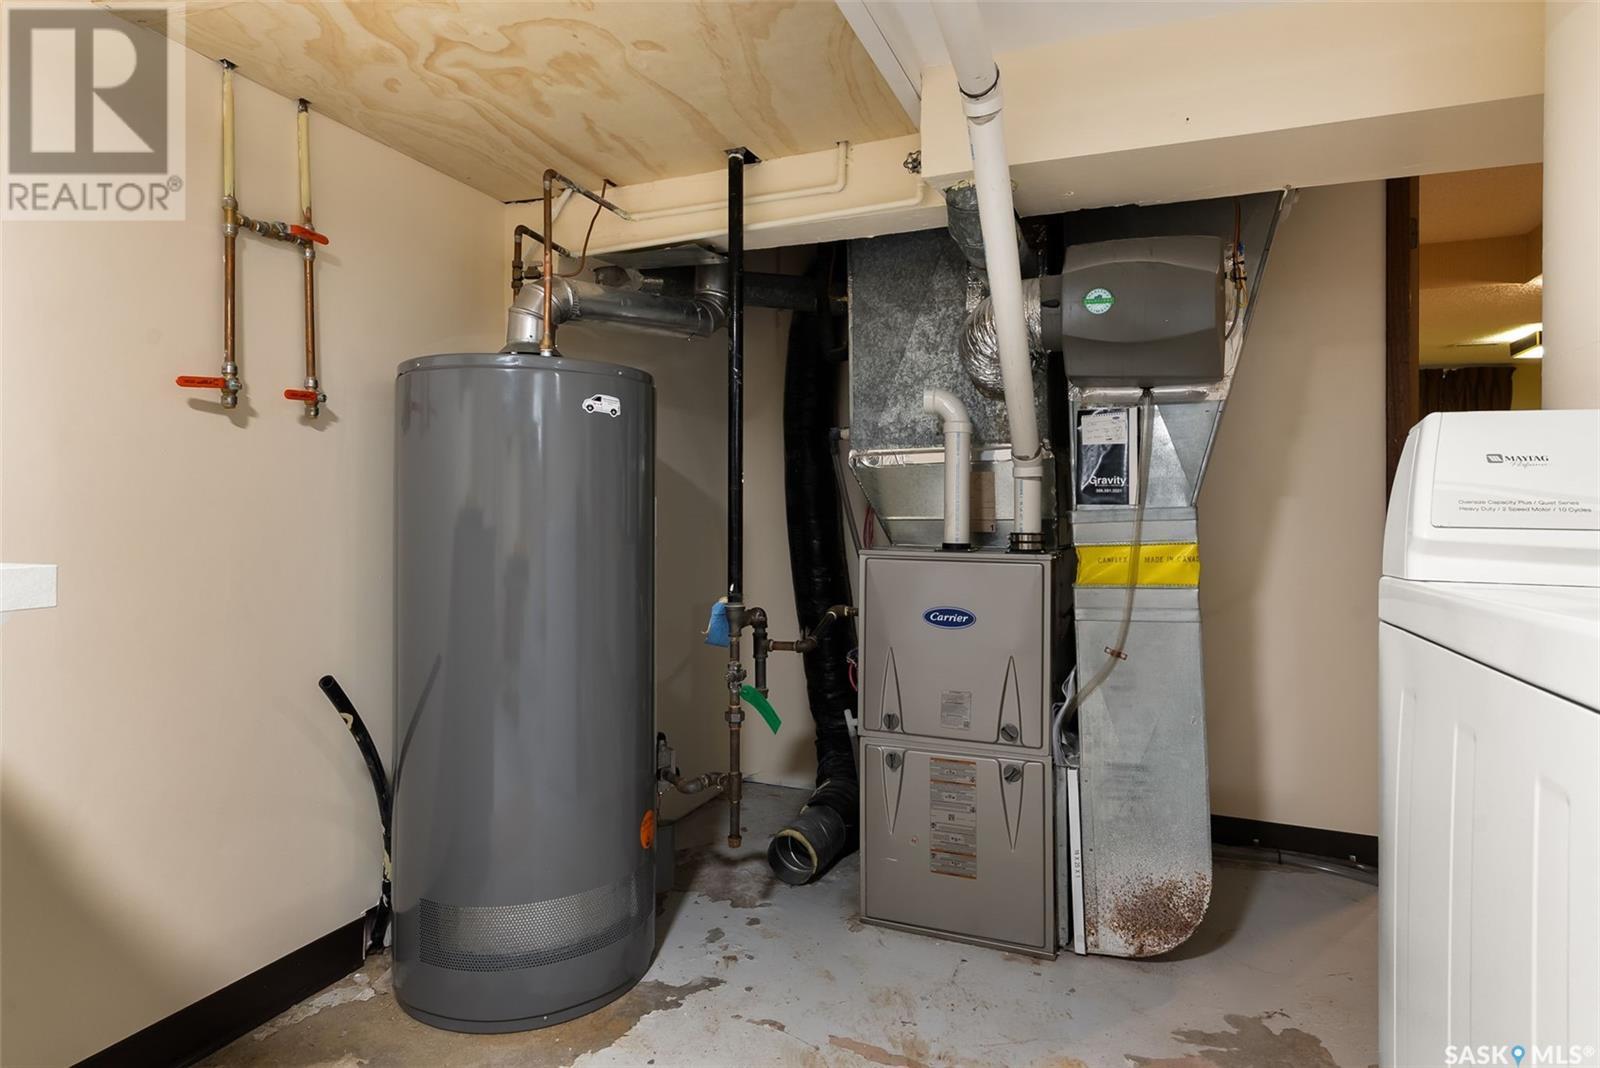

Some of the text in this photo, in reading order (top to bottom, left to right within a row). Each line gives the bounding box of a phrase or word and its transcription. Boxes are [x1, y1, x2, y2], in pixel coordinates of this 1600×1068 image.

[1089, 475, 1127, 487] Gravity
[1144, 556, 1164, 564] MADE
[929, 611, 969, 623] Carrier
